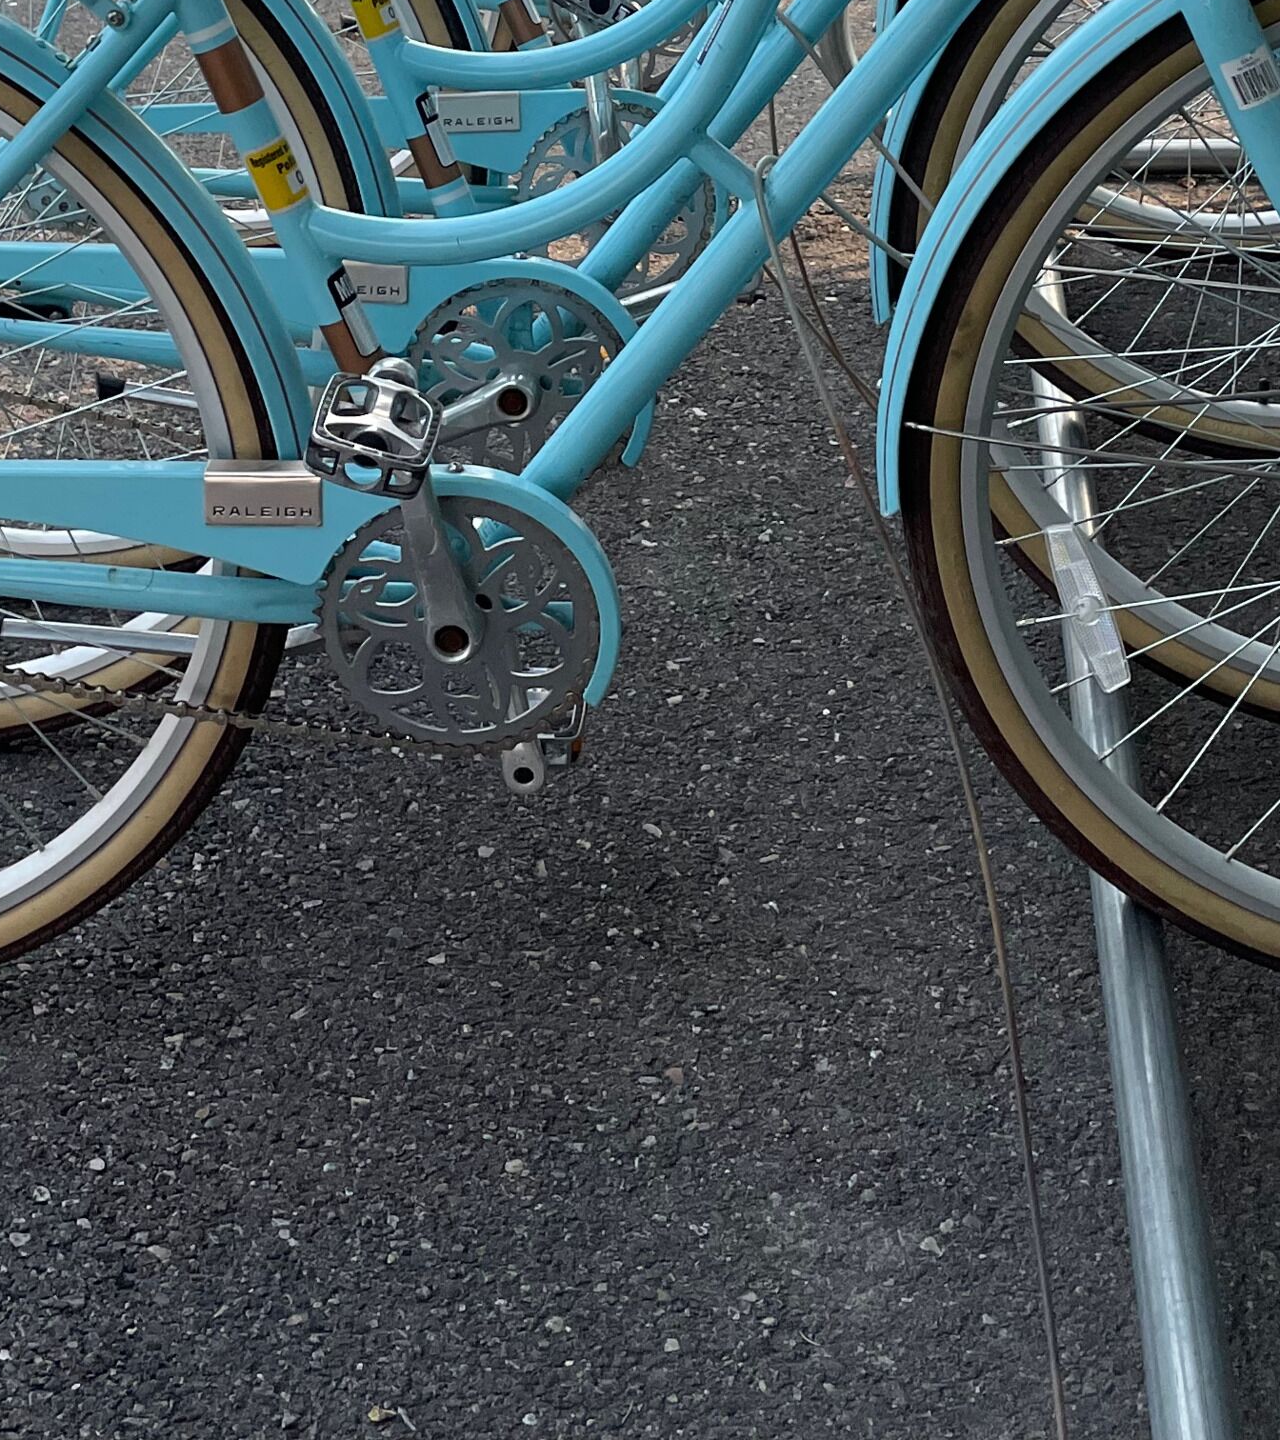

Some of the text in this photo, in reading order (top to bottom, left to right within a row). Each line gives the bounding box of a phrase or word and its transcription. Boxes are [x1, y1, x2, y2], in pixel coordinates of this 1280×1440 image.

[443, 116, 514, 127] RALEIGH
[356, 285, 401, 296] EIGH
[212, 506, 313, 517] RALEIGH
